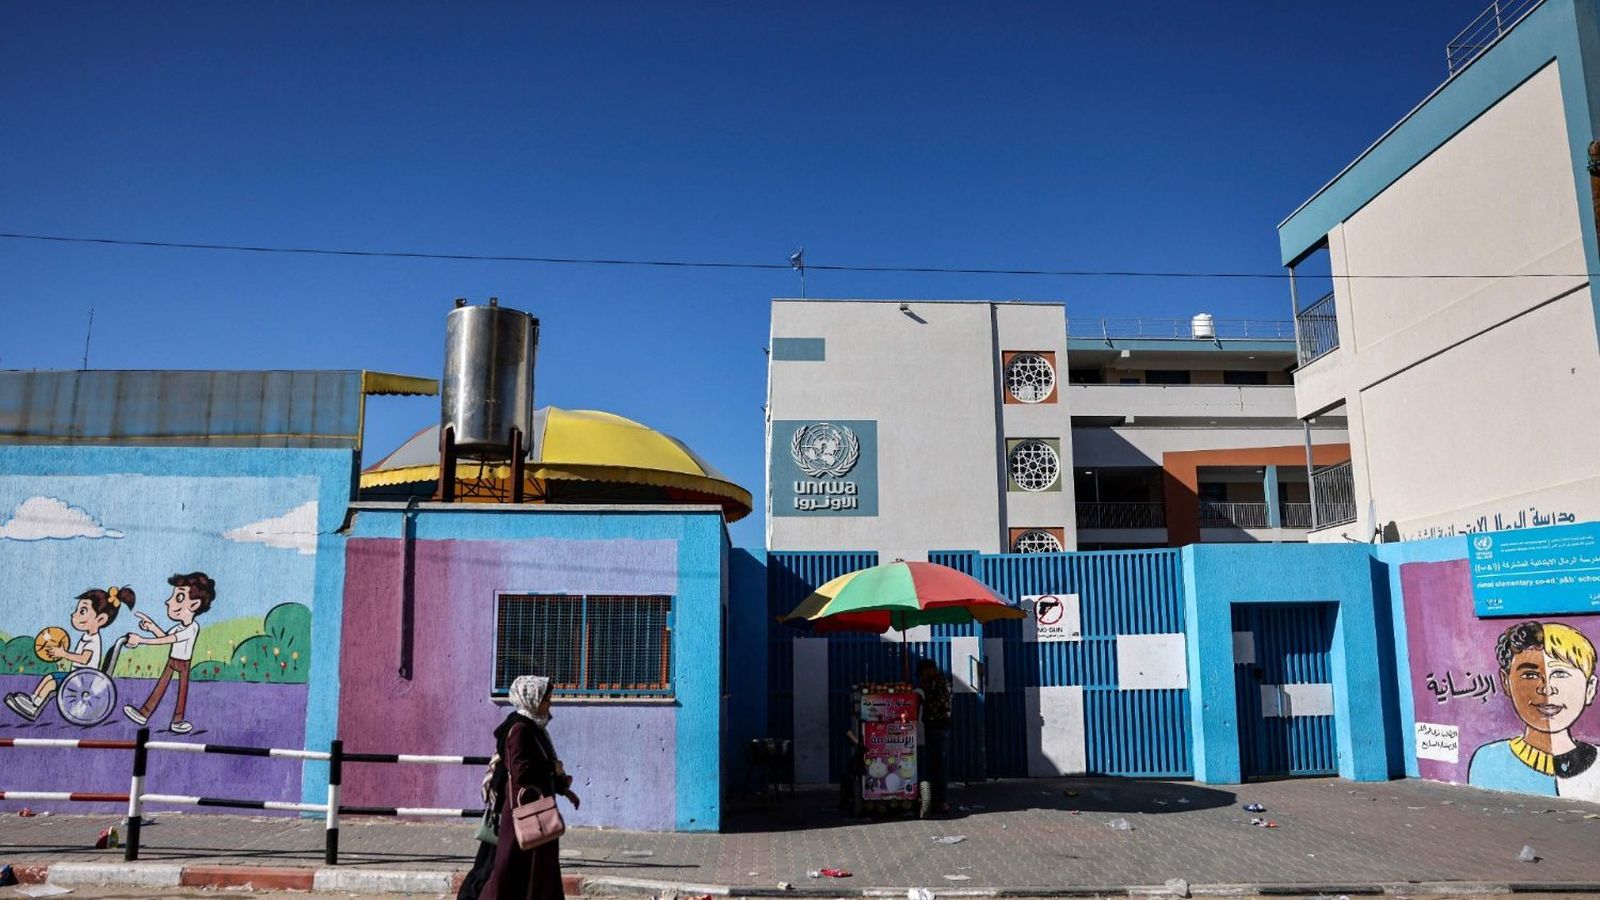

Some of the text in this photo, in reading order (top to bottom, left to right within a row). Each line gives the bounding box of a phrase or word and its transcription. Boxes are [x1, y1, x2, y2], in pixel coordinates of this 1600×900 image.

[794, 481, 857, 494] unrwa
[1495, 578, 1533, 588] elementary
[1535, 577, 1555, 585] co-ed
[1426, 671, 1496, 704] الإنسانية
